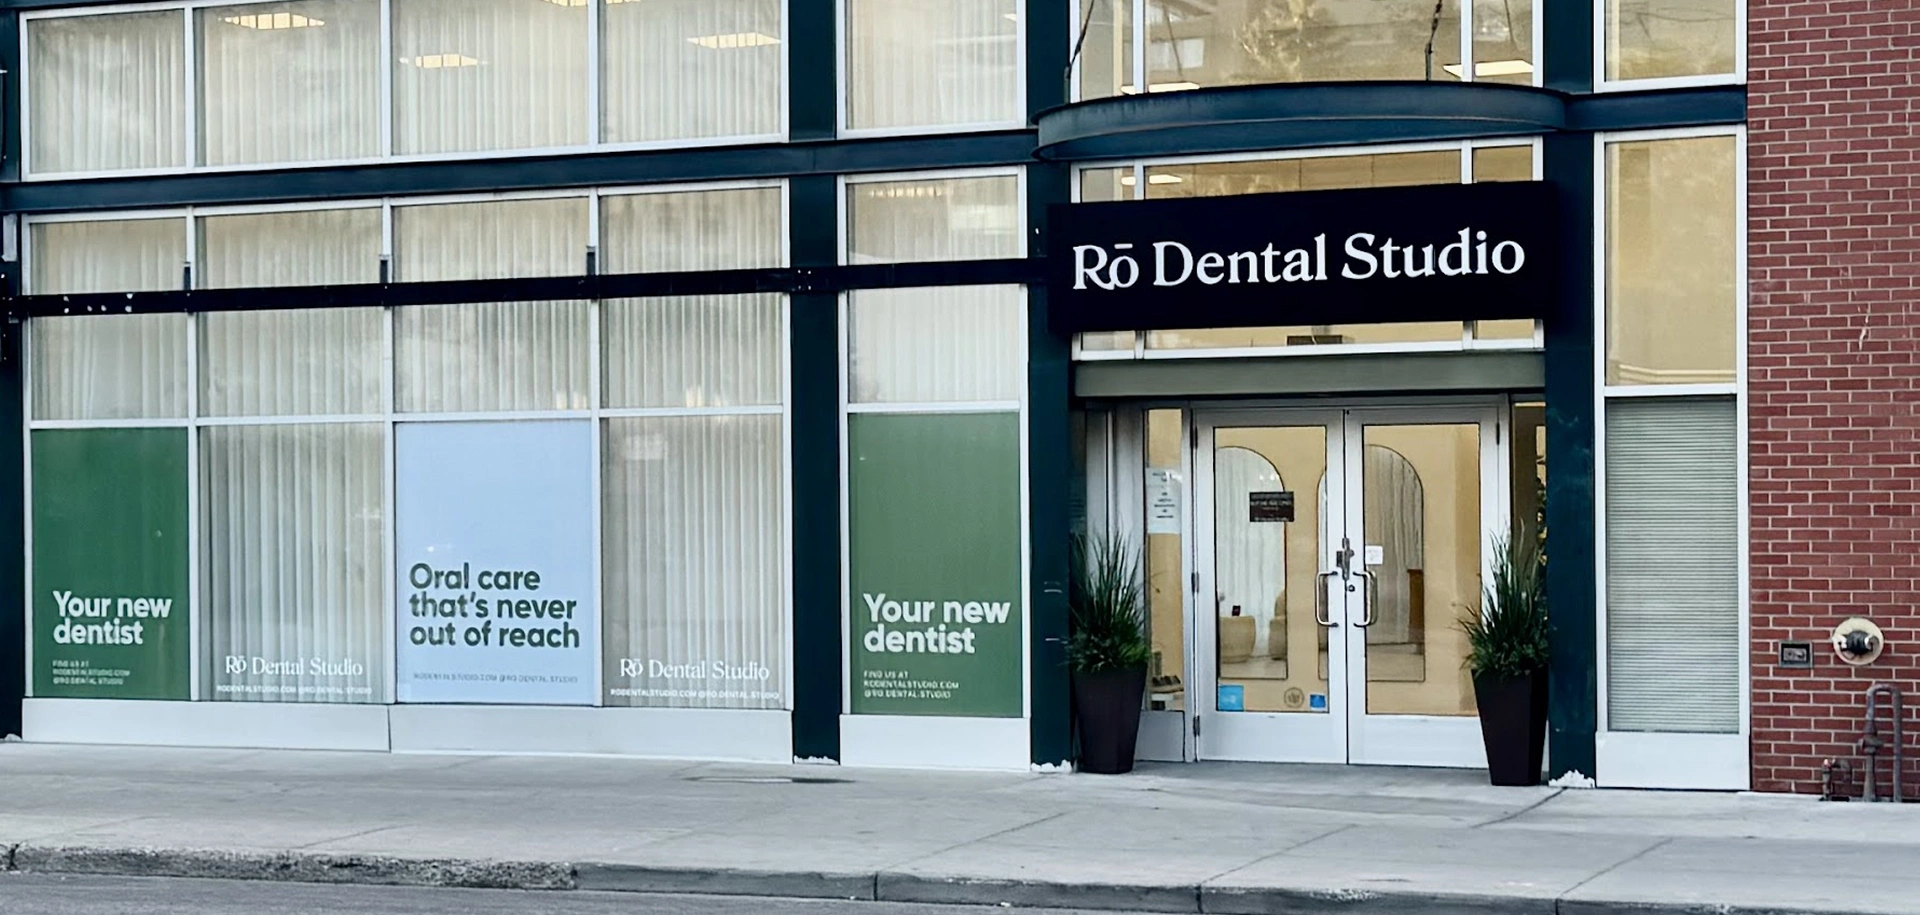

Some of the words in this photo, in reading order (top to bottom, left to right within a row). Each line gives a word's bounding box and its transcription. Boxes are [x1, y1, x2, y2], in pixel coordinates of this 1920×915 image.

[1072, 243, 1140, 290] Rō
[1152, 233, 1328, 286] Dental
[1341, 227, 1526, 280] Studio
[409, 562, 470, 590] Oral
[477, 570, 541, 591] care
[52, 590, 112, 618] Your
[117, 597, 172, 618] new
[409, 591, 490, 618] that's
[497, 599, 577, 619] never
[863, 593, 935, 623] Your
[943, 601, 1011, 624] new
[53, 617, 144, 645] dentist
[410, 622, 456, 646] out
[464, 620, 491, 646] of
[499, 621, 580, 648] reach
[863, 623, 976, 654] dentist
[225, 655, 248, 675] Rō
[252, 656, 305, 675] Dental
[309, 656, 364, 676] Studio
[620, 658, 644, 678] Rō
[649, 659, 706, 679] Dental
[712, 660, 770, 680] Studio
[863, 669, 883, 679] FIND
[884, 670, 897, 679] US
[898, 670, 909, 679] AT
